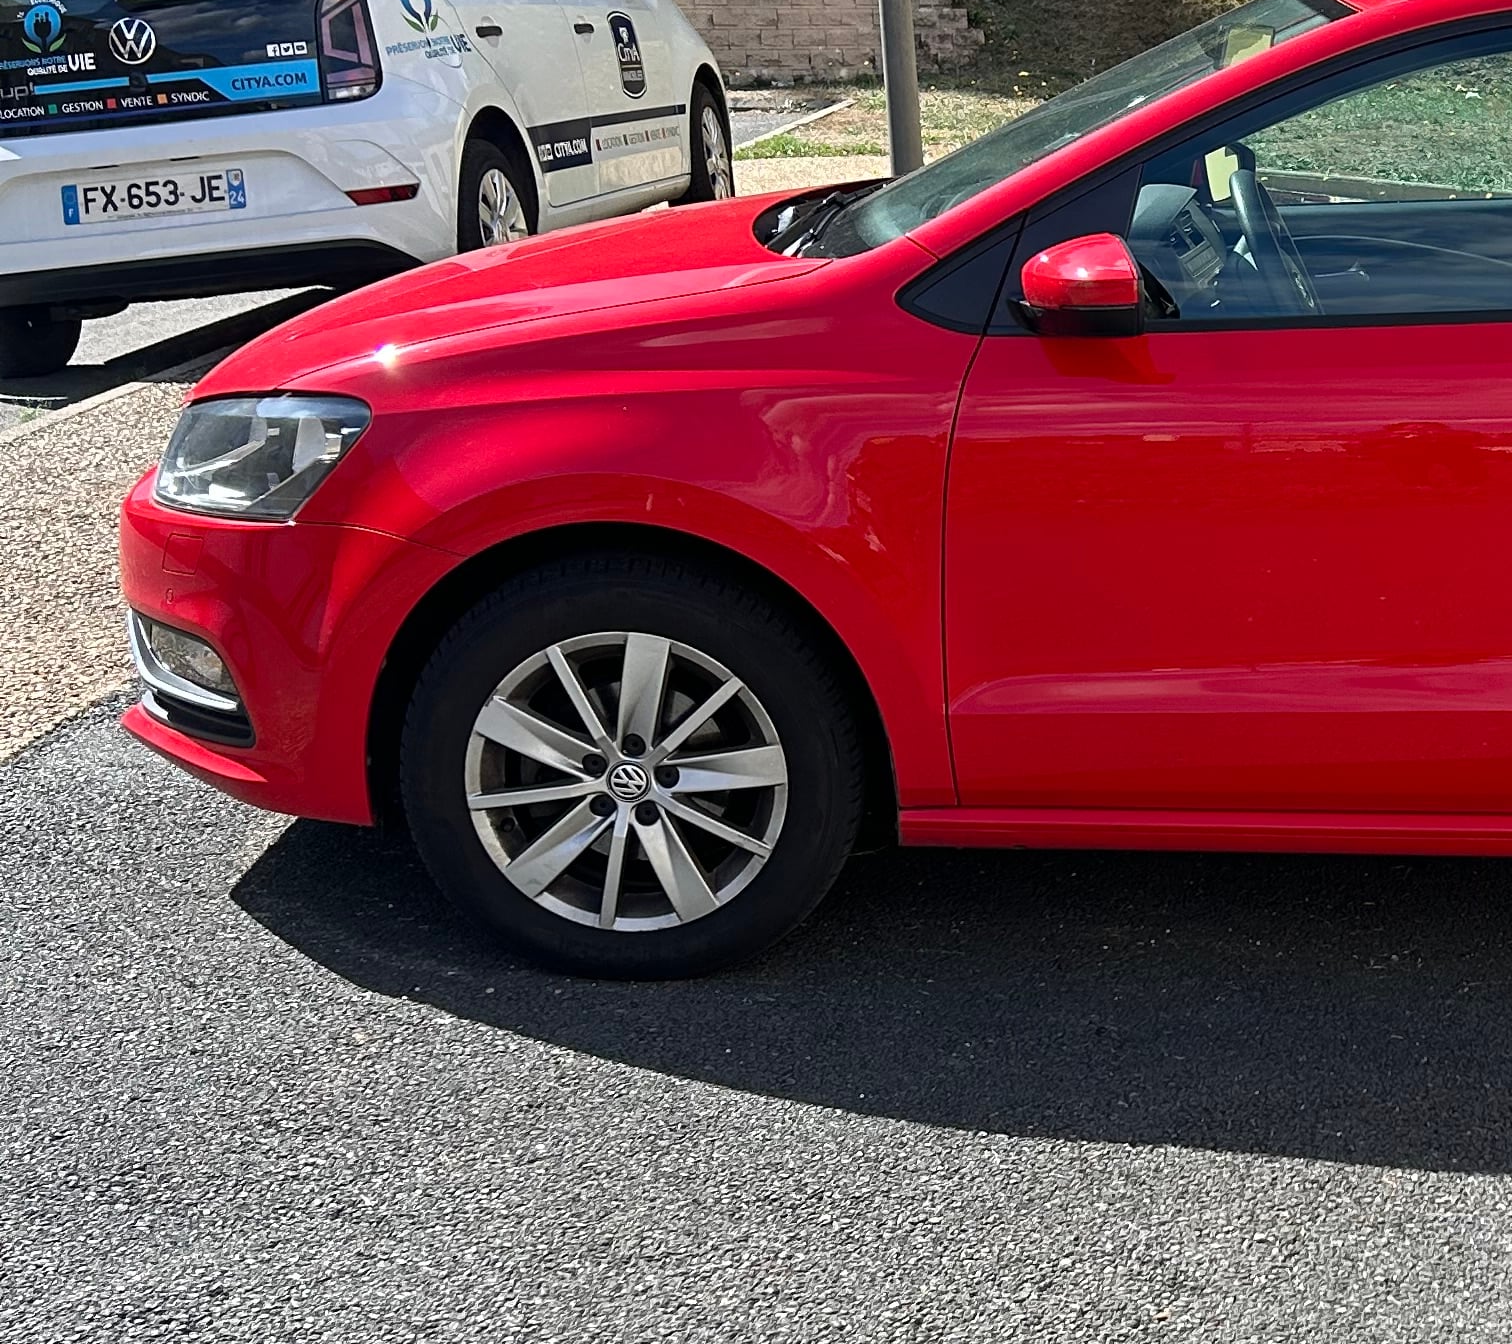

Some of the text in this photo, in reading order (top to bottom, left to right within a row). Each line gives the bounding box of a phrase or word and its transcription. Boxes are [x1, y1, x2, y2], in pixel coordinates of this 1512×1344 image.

[67, 52, 97, 72] VIE
[231, 71, 307, 91] CITYA.COM
[62, 100, 103, 113] GESTION
[121, 95, 153, 108] VENTE
[171, 90, 210, 104] SYNDIC
[83, 174, 225, 215] FX-653-JE
[229, 190, 245, 205] 24
